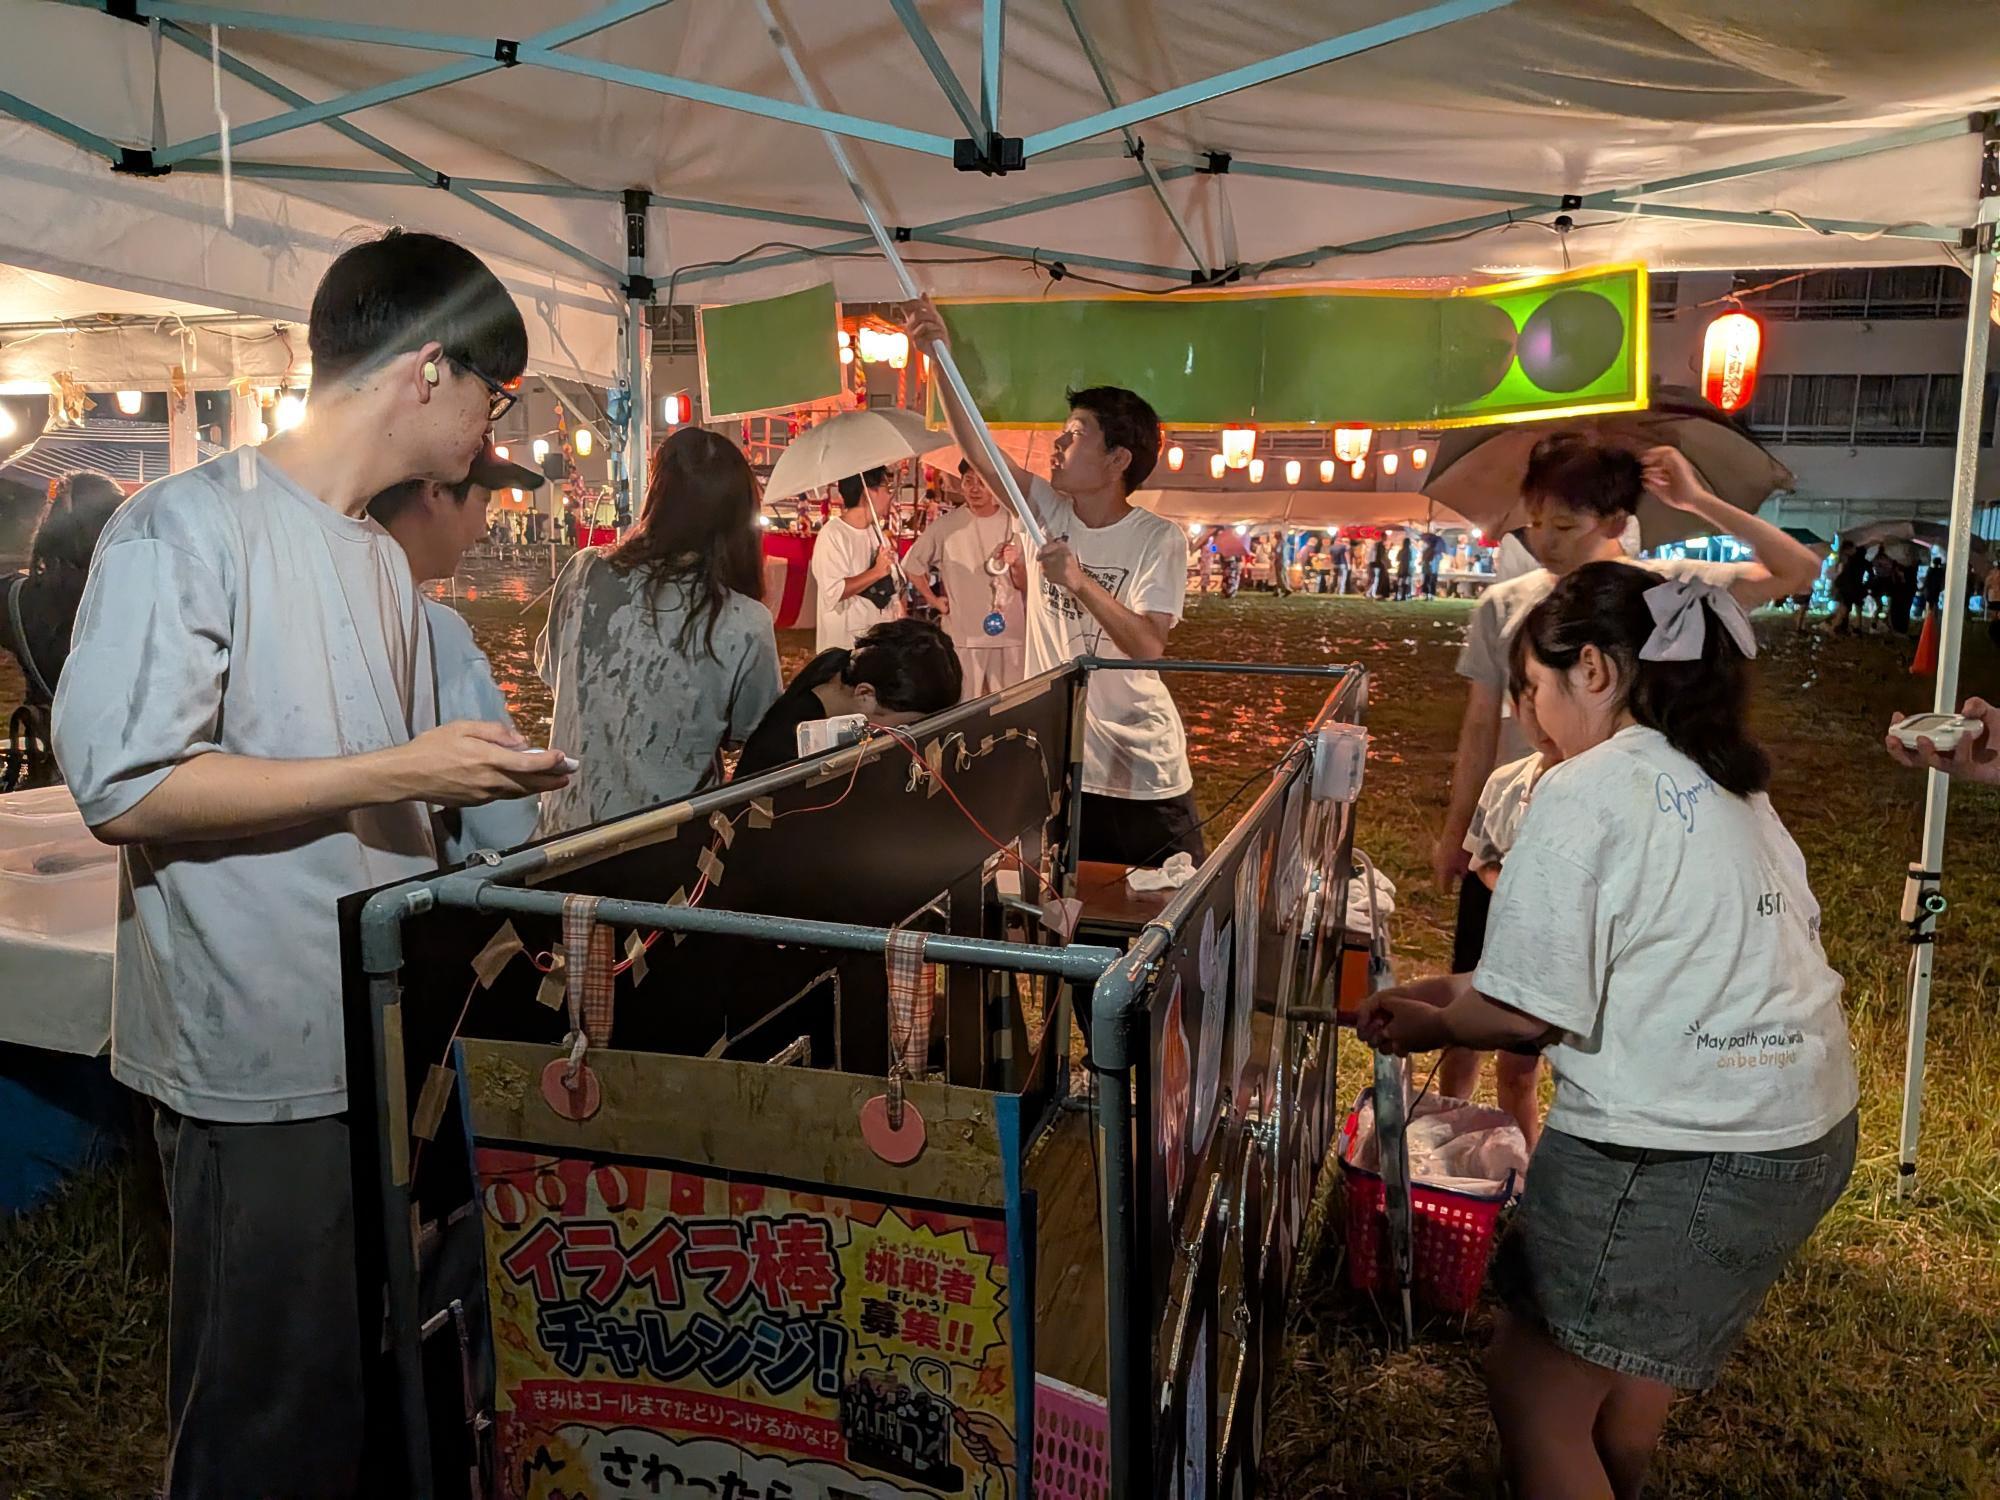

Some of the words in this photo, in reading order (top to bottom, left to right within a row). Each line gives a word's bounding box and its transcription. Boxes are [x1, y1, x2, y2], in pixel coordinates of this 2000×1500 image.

[1696, 1033, 1727, 1051] May
[1727, 1031, 1758, 1051] path
[1760, 1034, 1786, 1049] you
[502, 1218, 843, 1317] イライラ棒
[864, 1247, 977, 1306] 挑戦者
[537, 1301, 849, 1395] チャレンジ!
